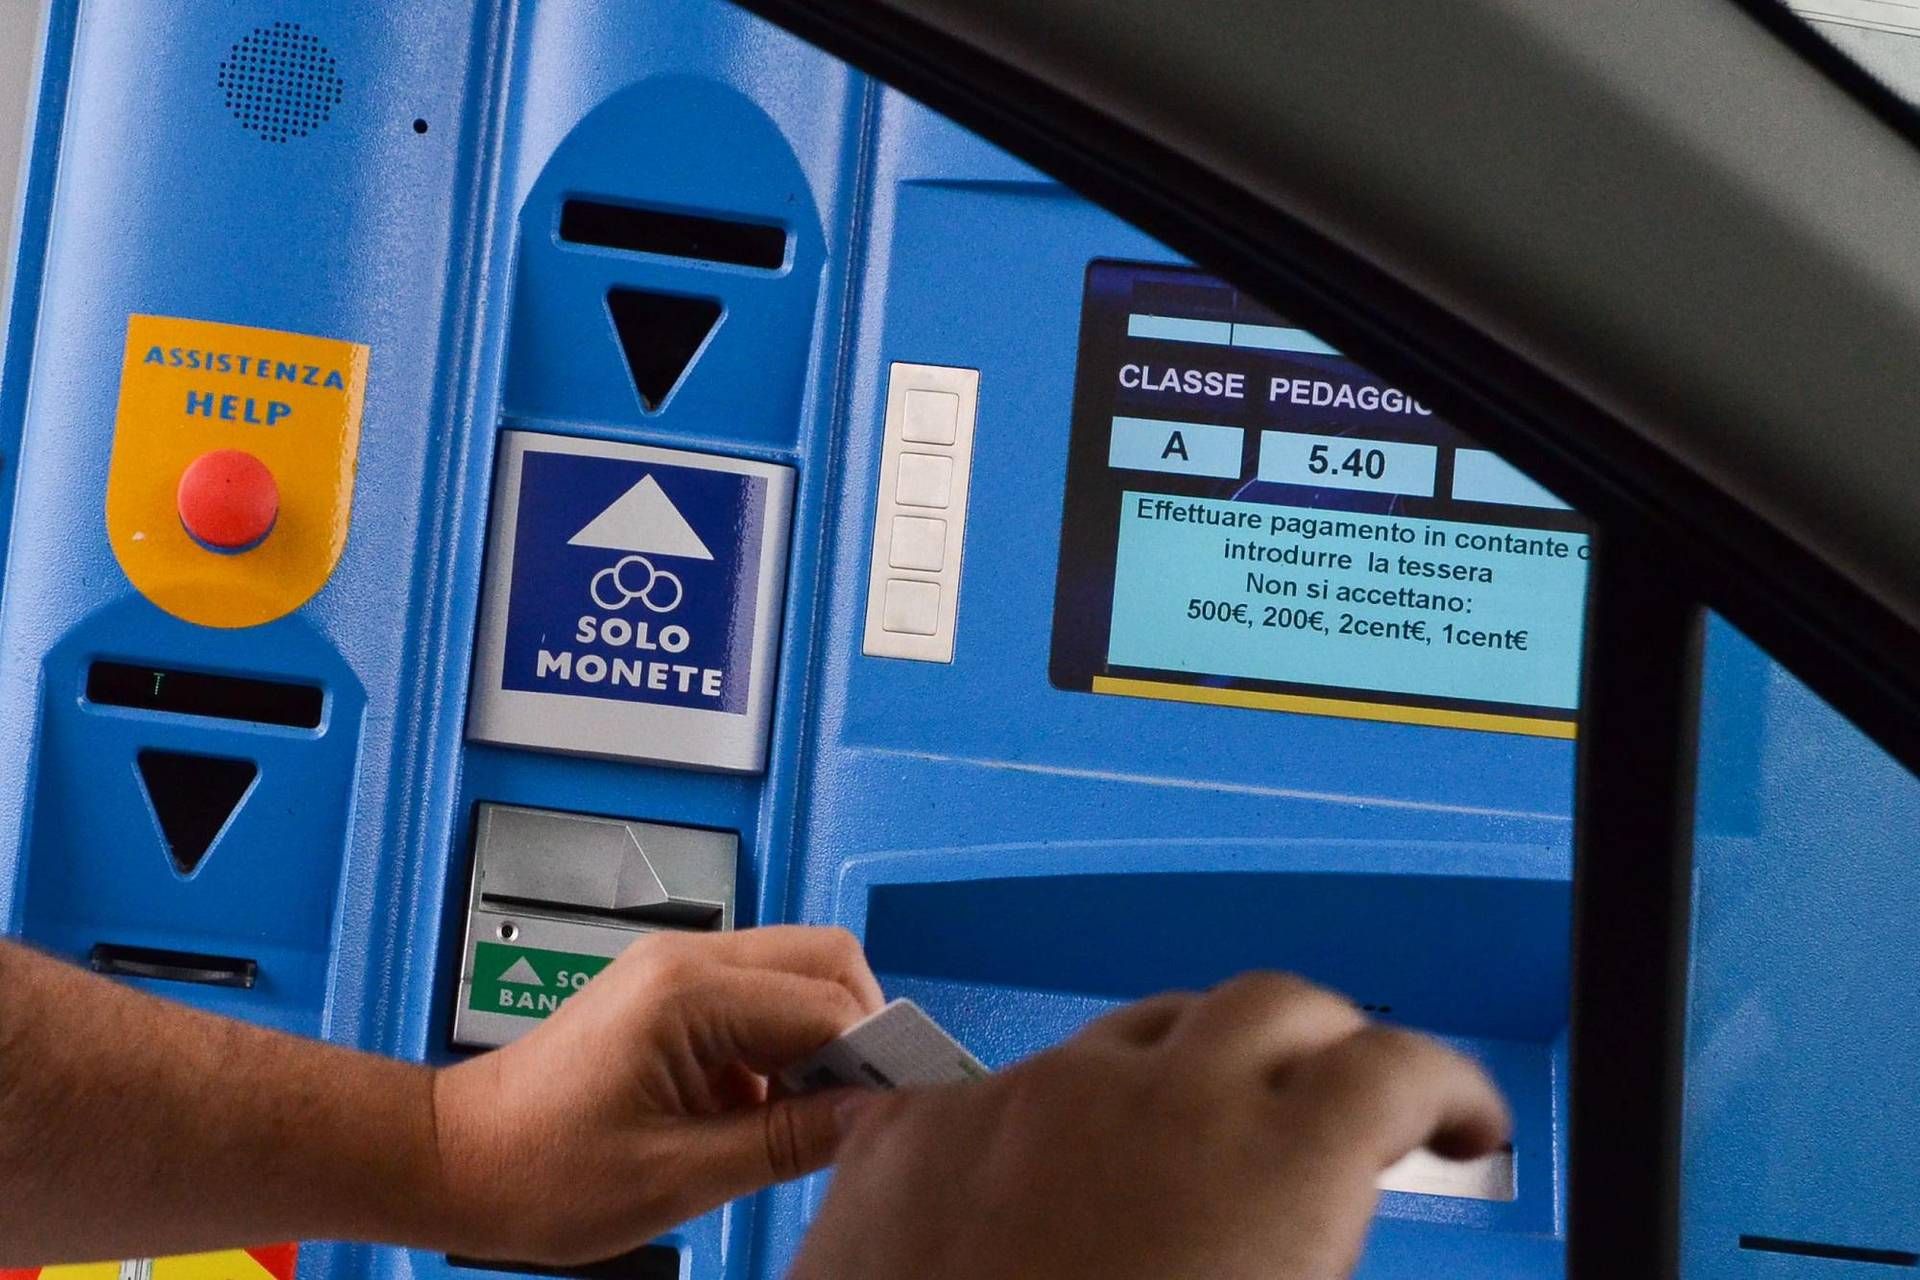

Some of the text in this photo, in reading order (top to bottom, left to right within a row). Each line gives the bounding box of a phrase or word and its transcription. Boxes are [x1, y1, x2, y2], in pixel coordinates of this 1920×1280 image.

[143, 345, 345, 391] ASSISTENZA
[1118, 363, 1245, 399] CLASSE
[185, 390, 292, 426] HELP
[1160, 430, 1386, 480] A 5.40
[1137, 497, 1263, 530] Effettuare
[1270, 514, 1416, 544] pagamento
[1423, 525, 1446, 547] in
[1455, 532, 1569, 558] contante
[1223, 538, 1493, 584] introdurre la tessera
[1246, 571, 1472, 614] Non si accettano:
[575, 615, 690, 654] SOLO
[1186, 598, 1529, 651] 500€, 200€, 2cent€, 1cent€
[536, 649, 724, 697] MONETE
